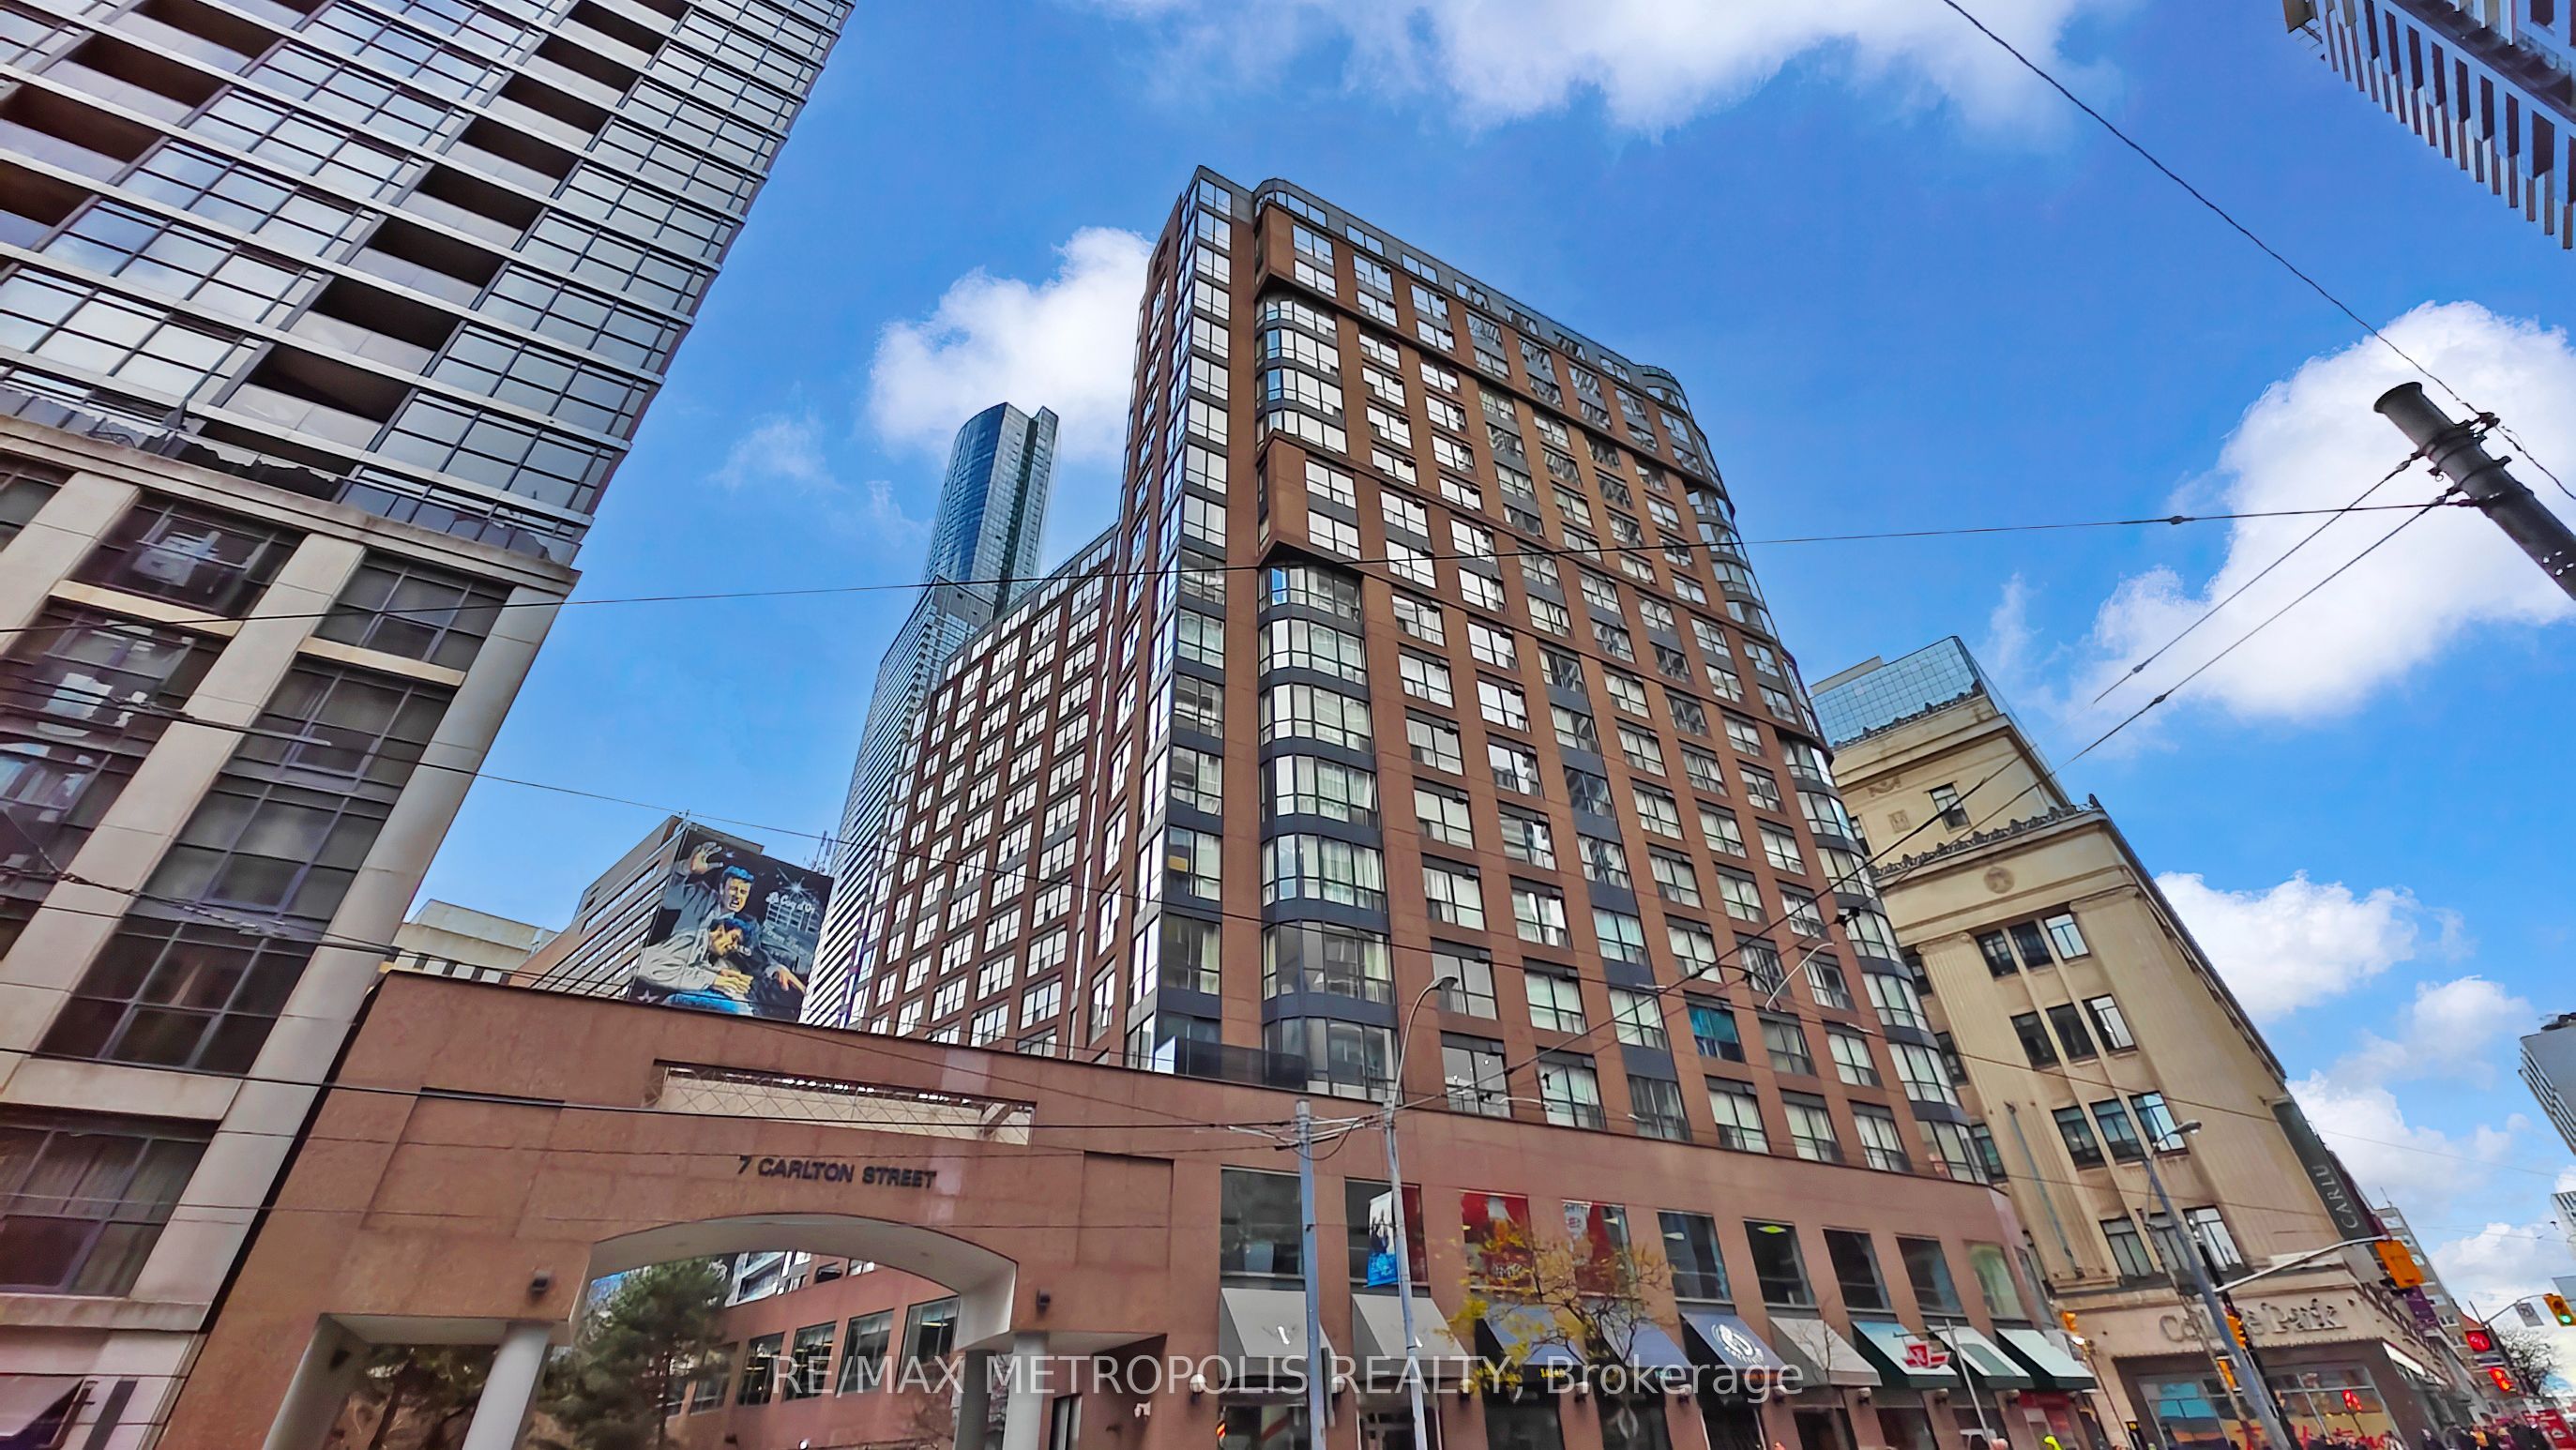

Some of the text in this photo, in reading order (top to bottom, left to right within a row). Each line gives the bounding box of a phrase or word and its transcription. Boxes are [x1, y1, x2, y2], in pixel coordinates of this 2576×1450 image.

[737, 1155, 937, 1188] 7 CARLTON STREET
[2312, 1164, 2358, 1229] CARLU
